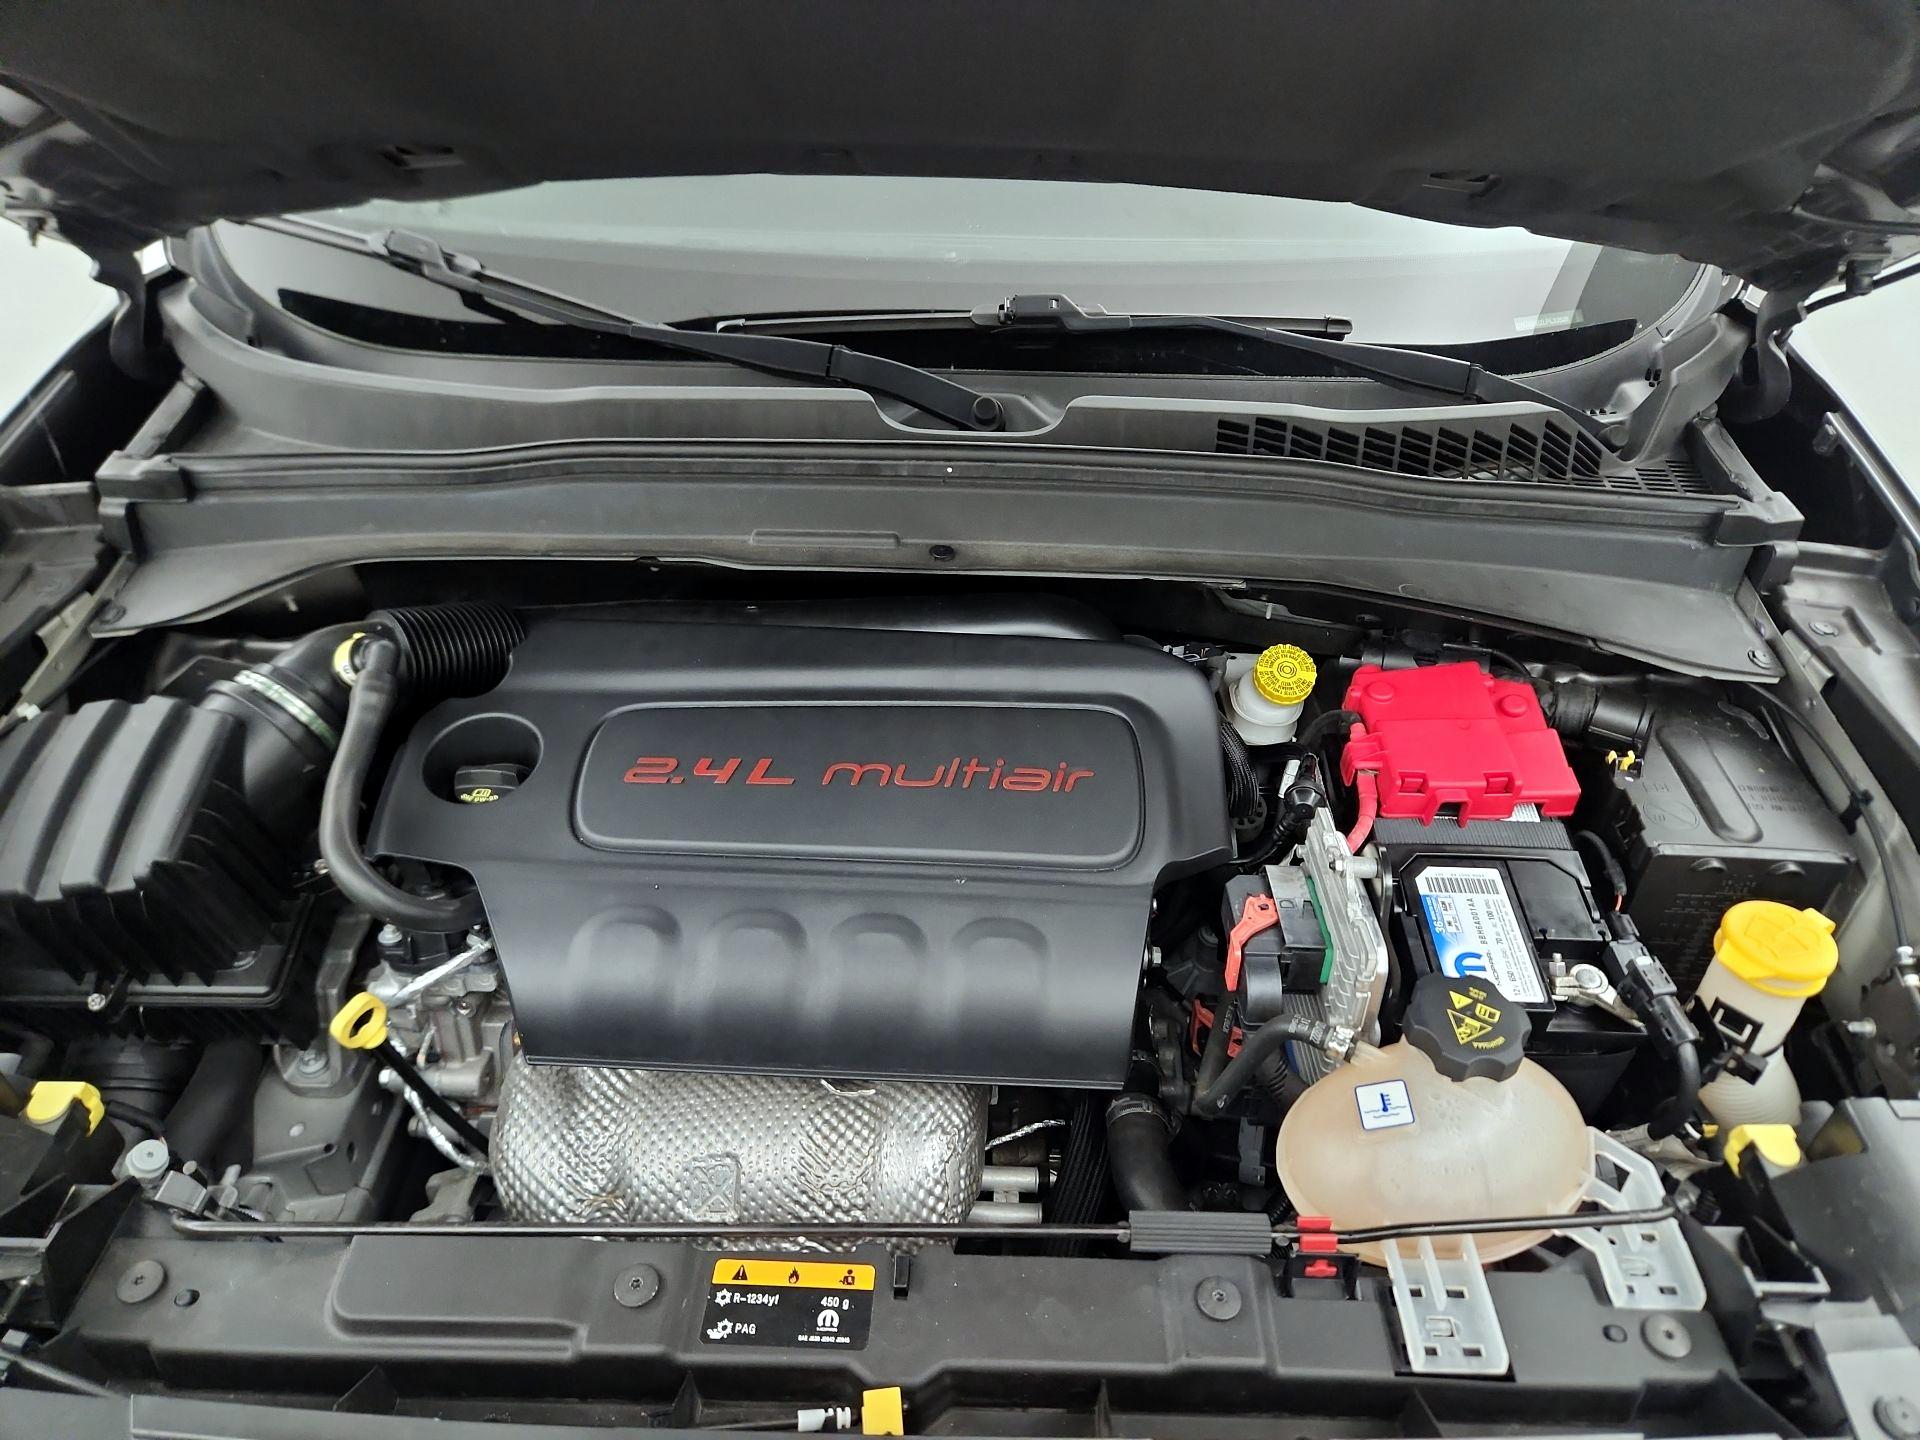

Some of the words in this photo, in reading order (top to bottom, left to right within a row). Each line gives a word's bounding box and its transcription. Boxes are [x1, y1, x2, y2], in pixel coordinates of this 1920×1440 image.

[822, 758, 1095, 793] multiair
[821, 1297, 839, 1308] 450
[735, 1322, 756, 1335] PAG
